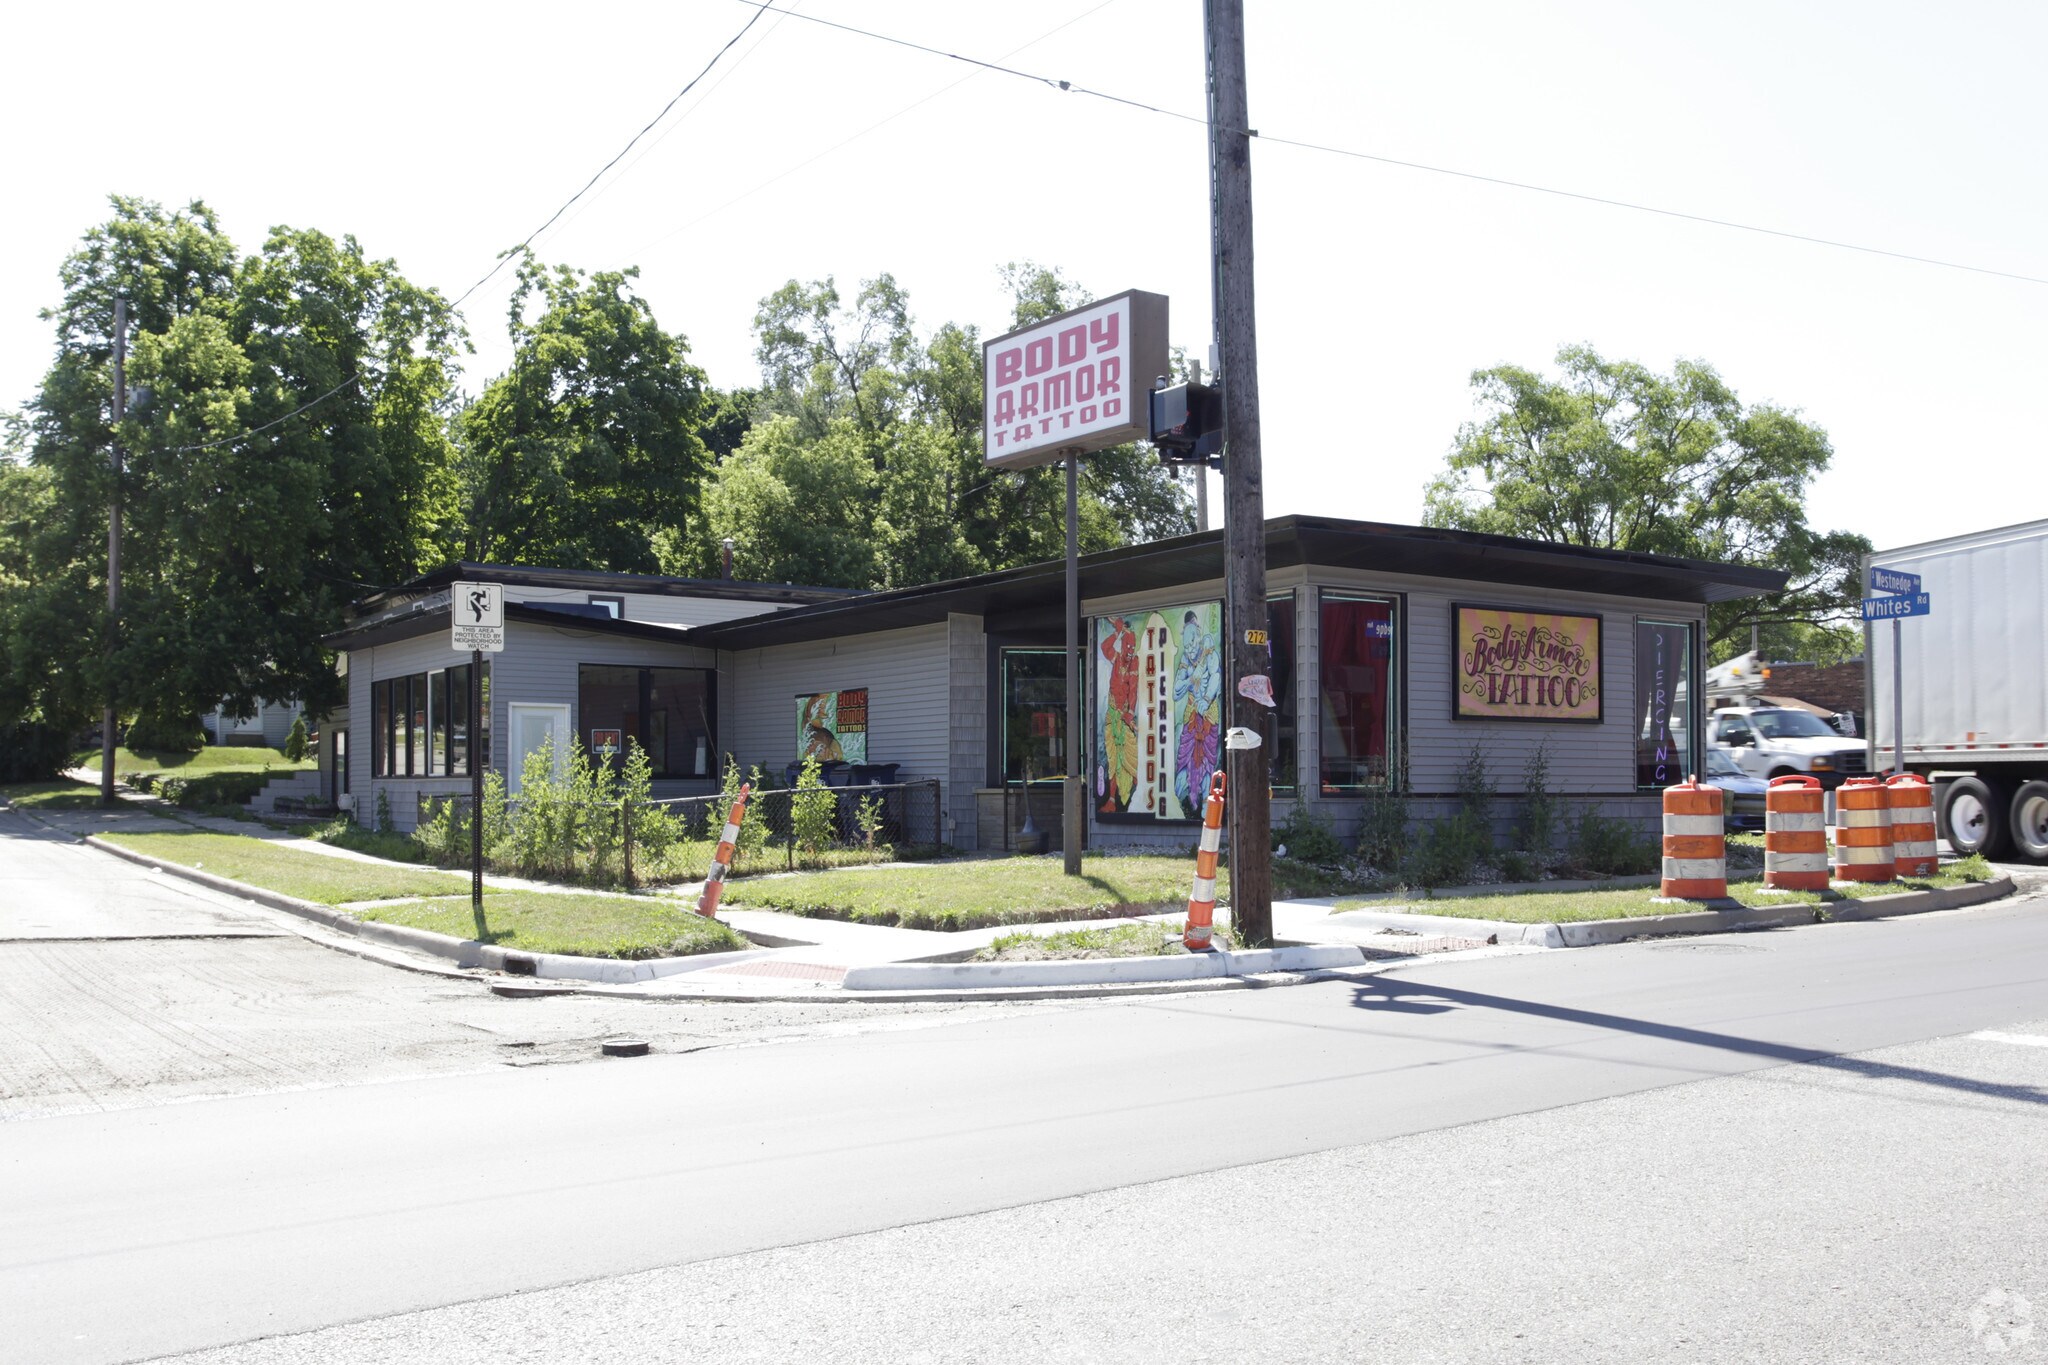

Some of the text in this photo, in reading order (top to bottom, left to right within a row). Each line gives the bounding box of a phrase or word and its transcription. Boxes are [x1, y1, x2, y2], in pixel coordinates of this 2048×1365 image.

[995, 312, 1119, 388] BODY
[993, 356, 1121, 427] ARMOR
[993, 398, 1121, 447] TATTOO
[1865, 595, 1927, 617] Whites Rd
[1875, 571, 1912, 595] Westnedge
[1465, 624, 1590, 676] Body Armor
[1485, 672, 1581, 707] TATTOO
[1146, 626, 1156, 810] TATTOOS
[1158, 627, 1168, 817] PIERCING
